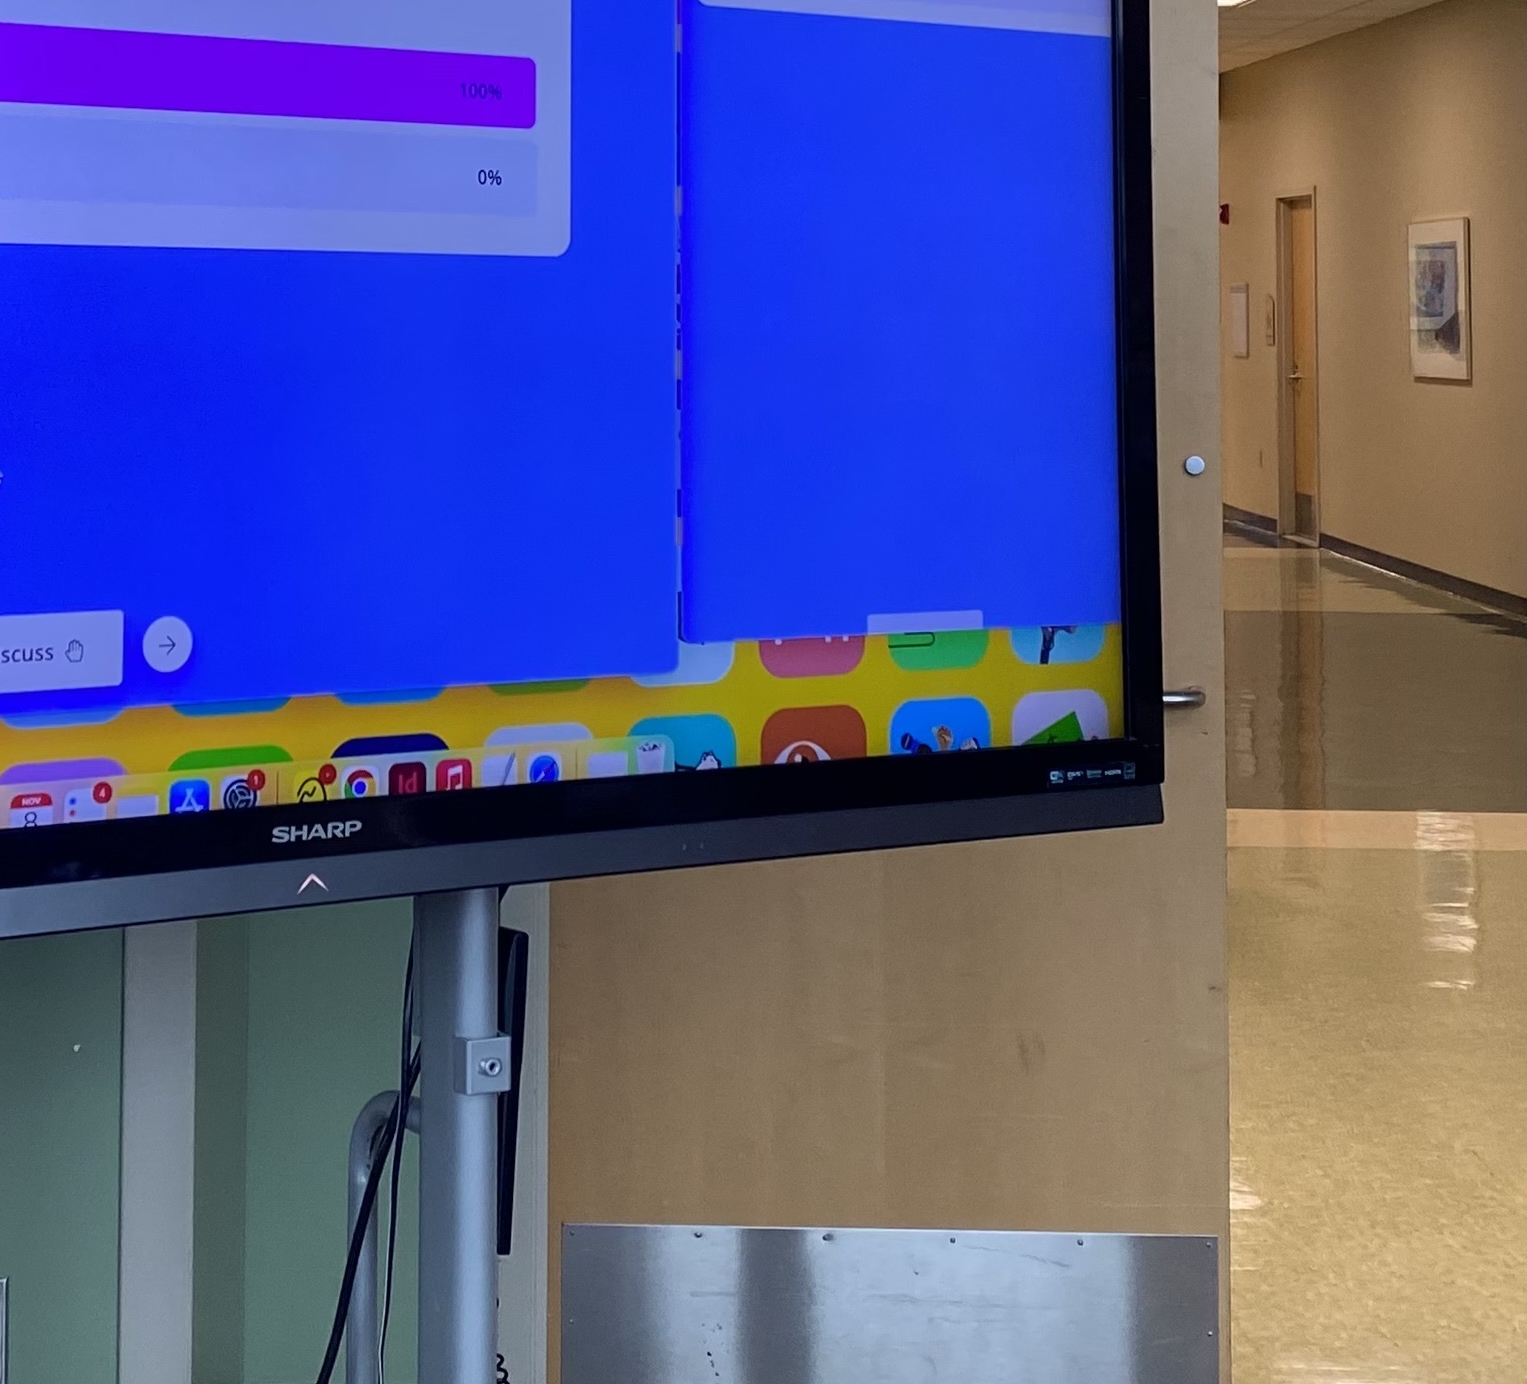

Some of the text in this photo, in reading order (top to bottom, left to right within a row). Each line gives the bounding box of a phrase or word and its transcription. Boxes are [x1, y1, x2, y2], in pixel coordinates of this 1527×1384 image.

[460, 82, 502, 99] 100%
[477, 169, 503, 186] 0%
[21, 796, 42, 807] NOV
[98, 786, 107, 800] 4
[271, 819, 363, 844] SHARP
